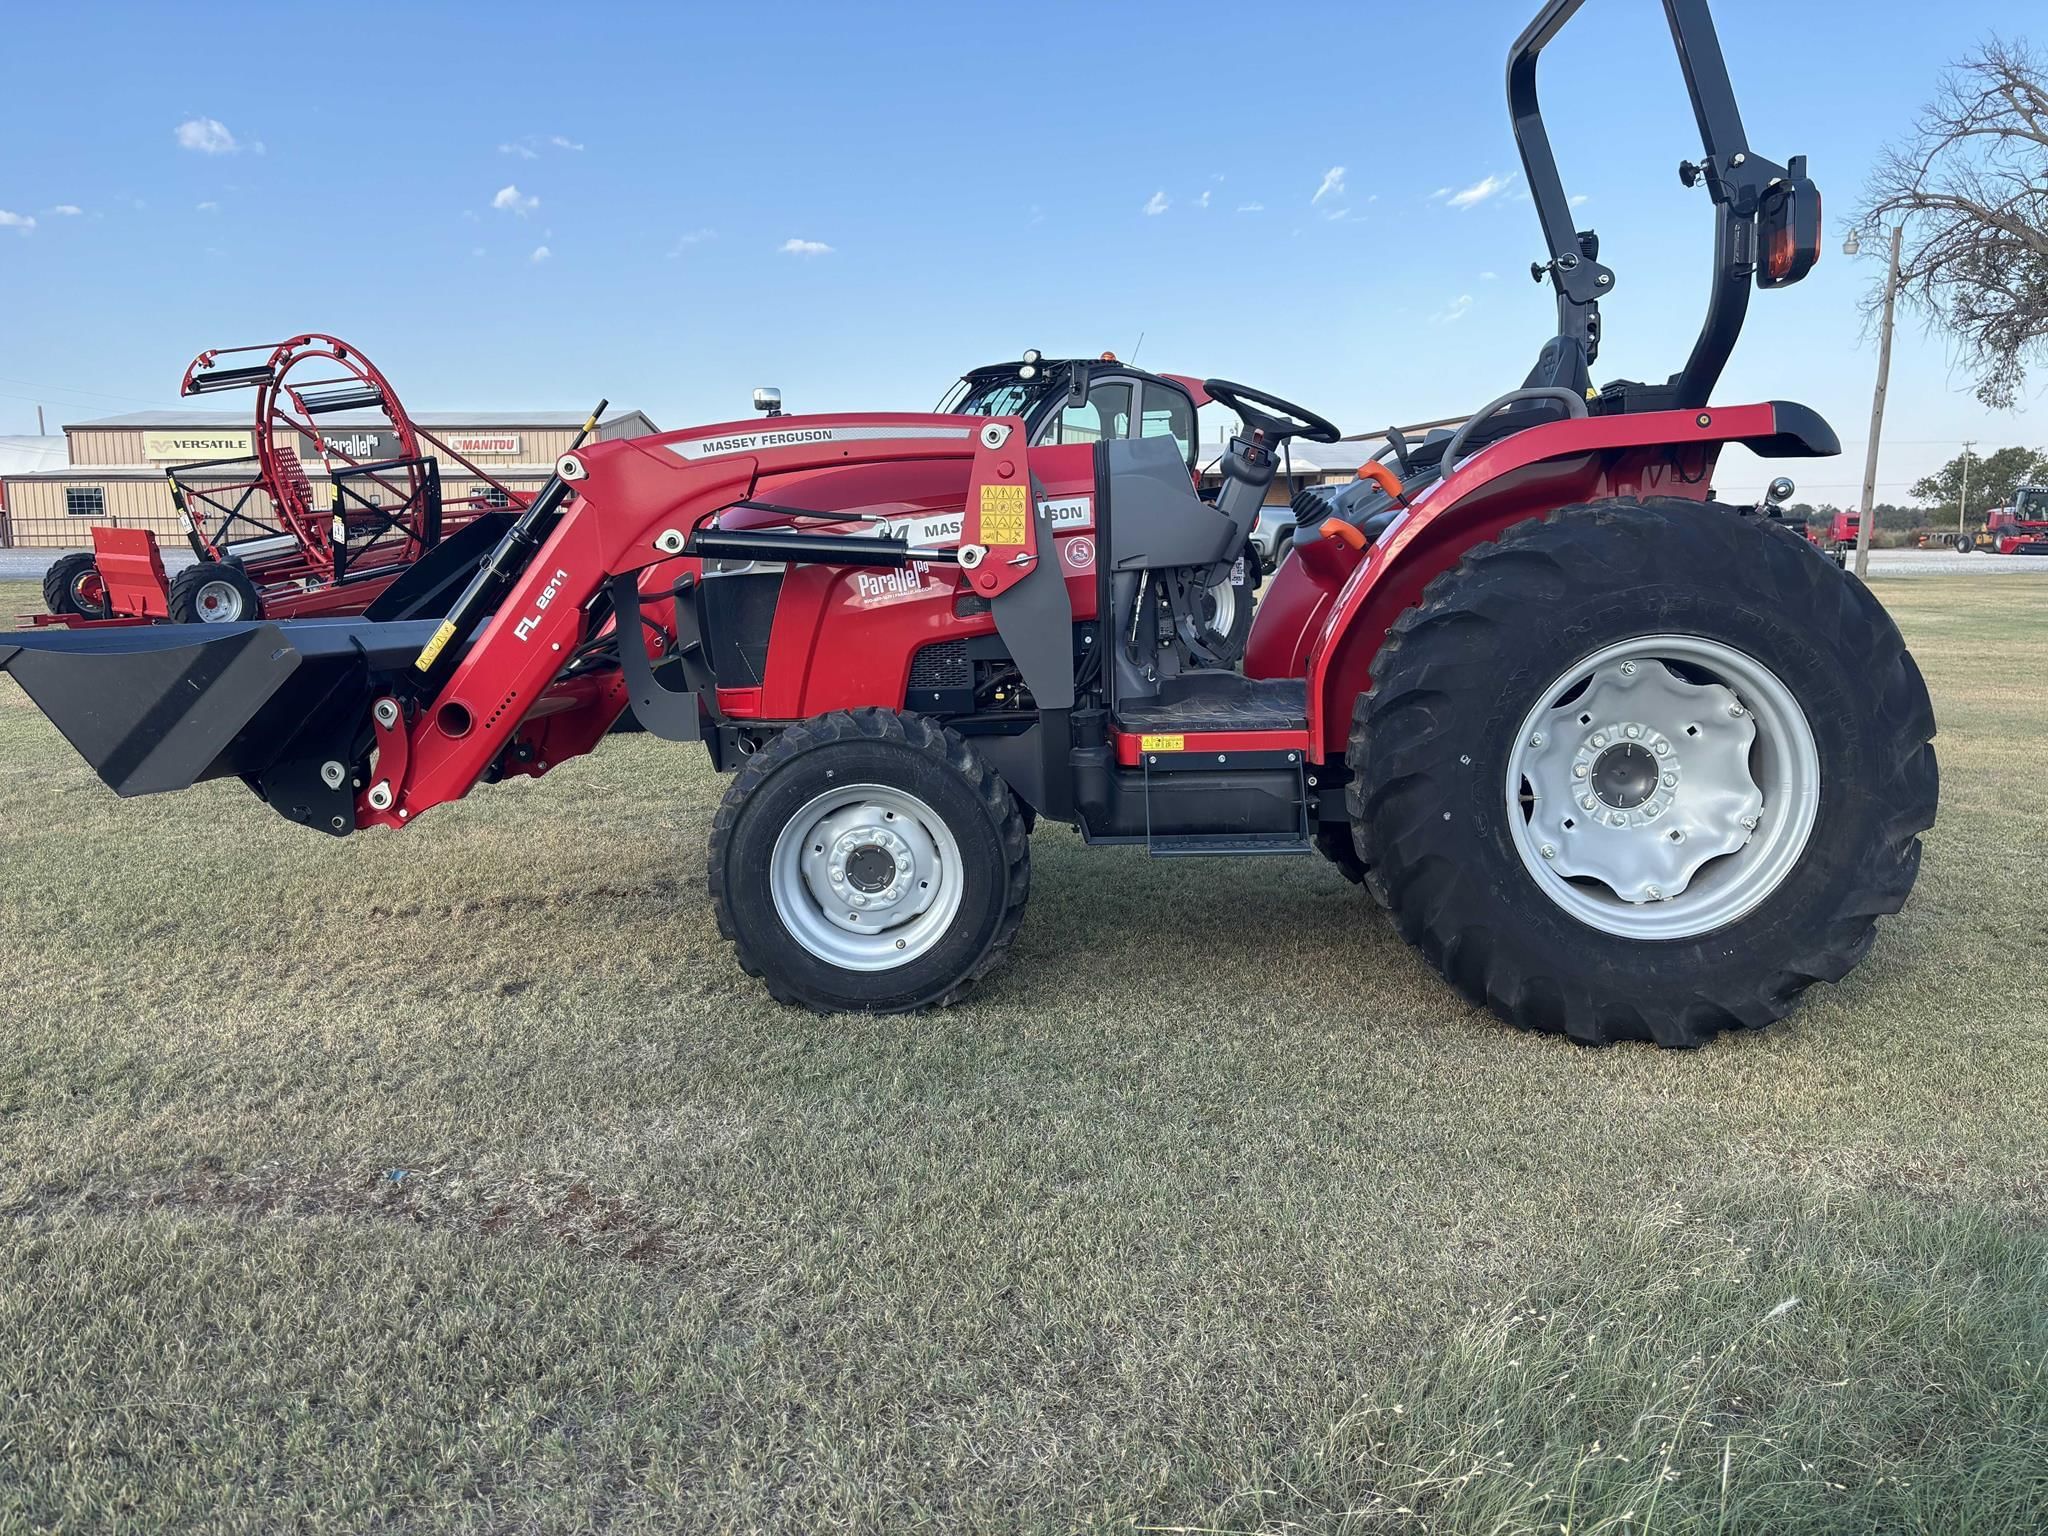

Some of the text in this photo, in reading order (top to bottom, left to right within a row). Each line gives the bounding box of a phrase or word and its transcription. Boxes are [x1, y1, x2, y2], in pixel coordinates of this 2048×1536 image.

[173, 440, 248, 449] VERSATILE
[462, 439, 515, 450] MANITOU
[702, 430, 833, 453] MASSEY FERGUSON
[513, 569, 568, 641] FL 2611
